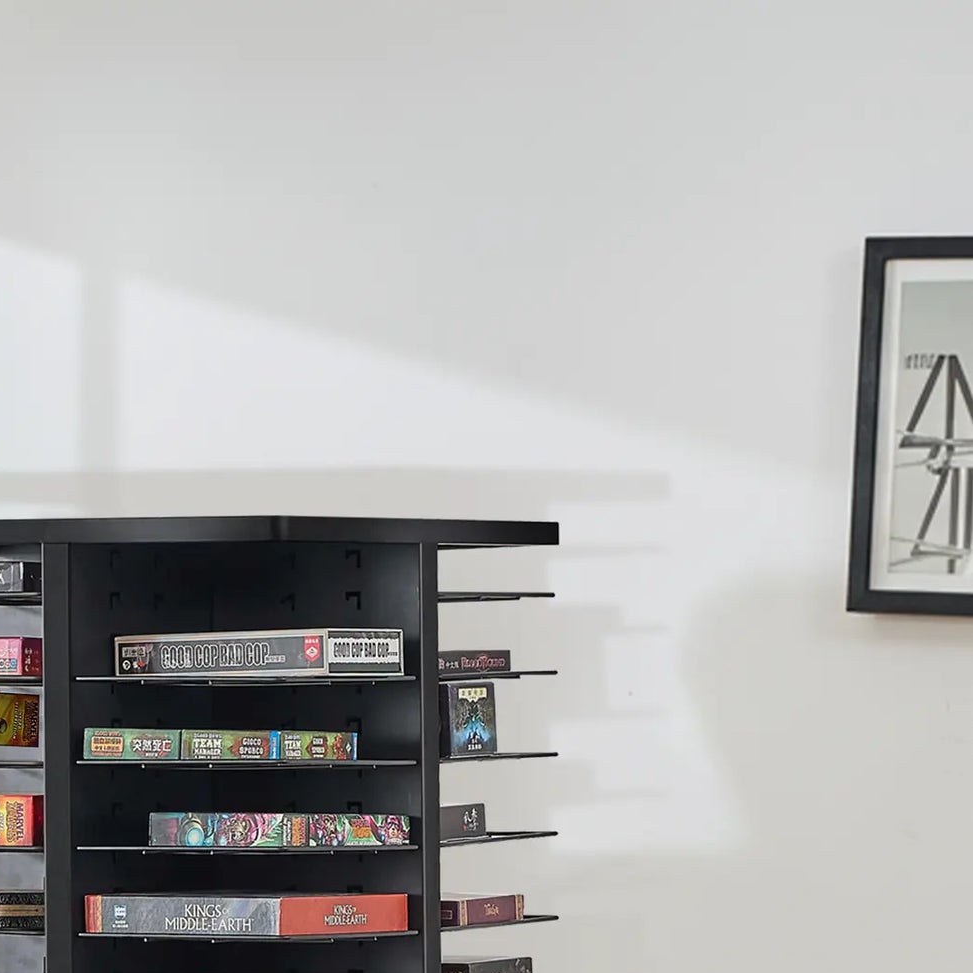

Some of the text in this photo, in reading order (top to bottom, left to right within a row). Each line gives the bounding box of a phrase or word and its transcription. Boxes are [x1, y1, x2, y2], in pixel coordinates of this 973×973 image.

[161, 645, 194, 669] GOOD
[194, 644, 217, 668] COP
[219, 643, 243, 667] BAD
[245, 642, 269, 666] COP
[351, 642, 363, 657] COP
[364, 642, 376, 657] BAD
[377, 642, 389, 657] COP
[132, 739, 172, 752] 突然死亡
[193, 739, 222, 748] TEAM
[16, 802, 25, 841] MARVEL
[184, 904, 222, 918] KINGS
[333, 904, 352, 915] KINGS
[164, 917, 253, 931] MIDDLE-EARTH
[324, 914, 368, 925] MIDDLE-EARTH
